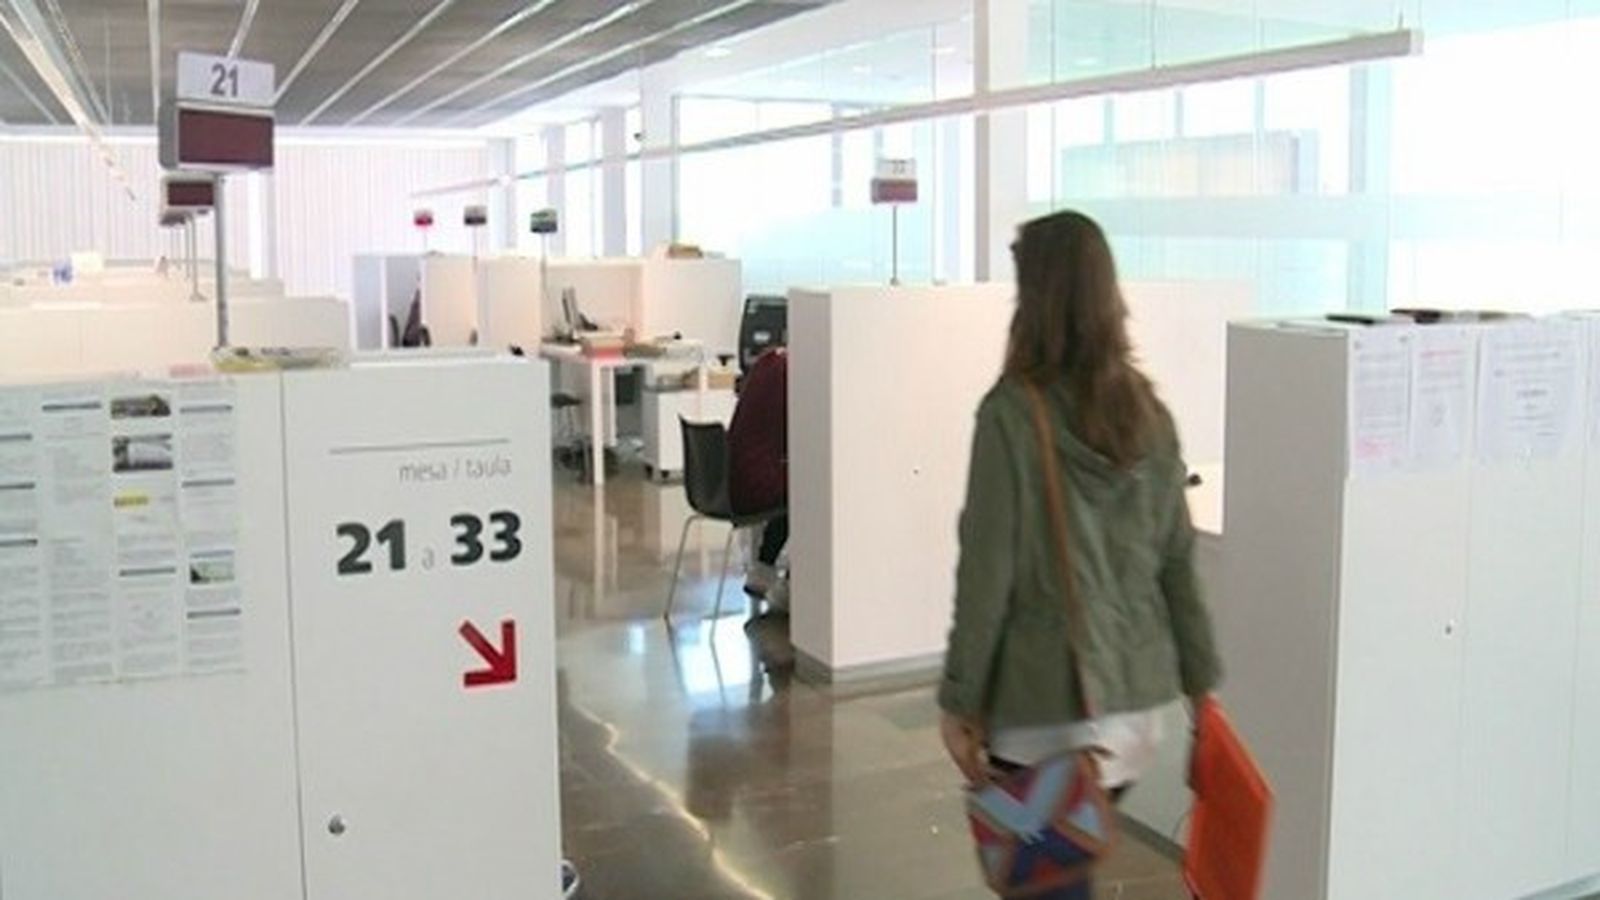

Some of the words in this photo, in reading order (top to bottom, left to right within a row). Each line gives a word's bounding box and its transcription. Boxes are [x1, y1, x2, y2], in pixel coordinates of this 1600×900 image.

[210, 63, 239, 98] 21
[399, 463, 447, 482] mesa
[466, 456, 512, 477] taula
[336, 518, 406, 575] 21
[450, 510, 523, 566] 33
